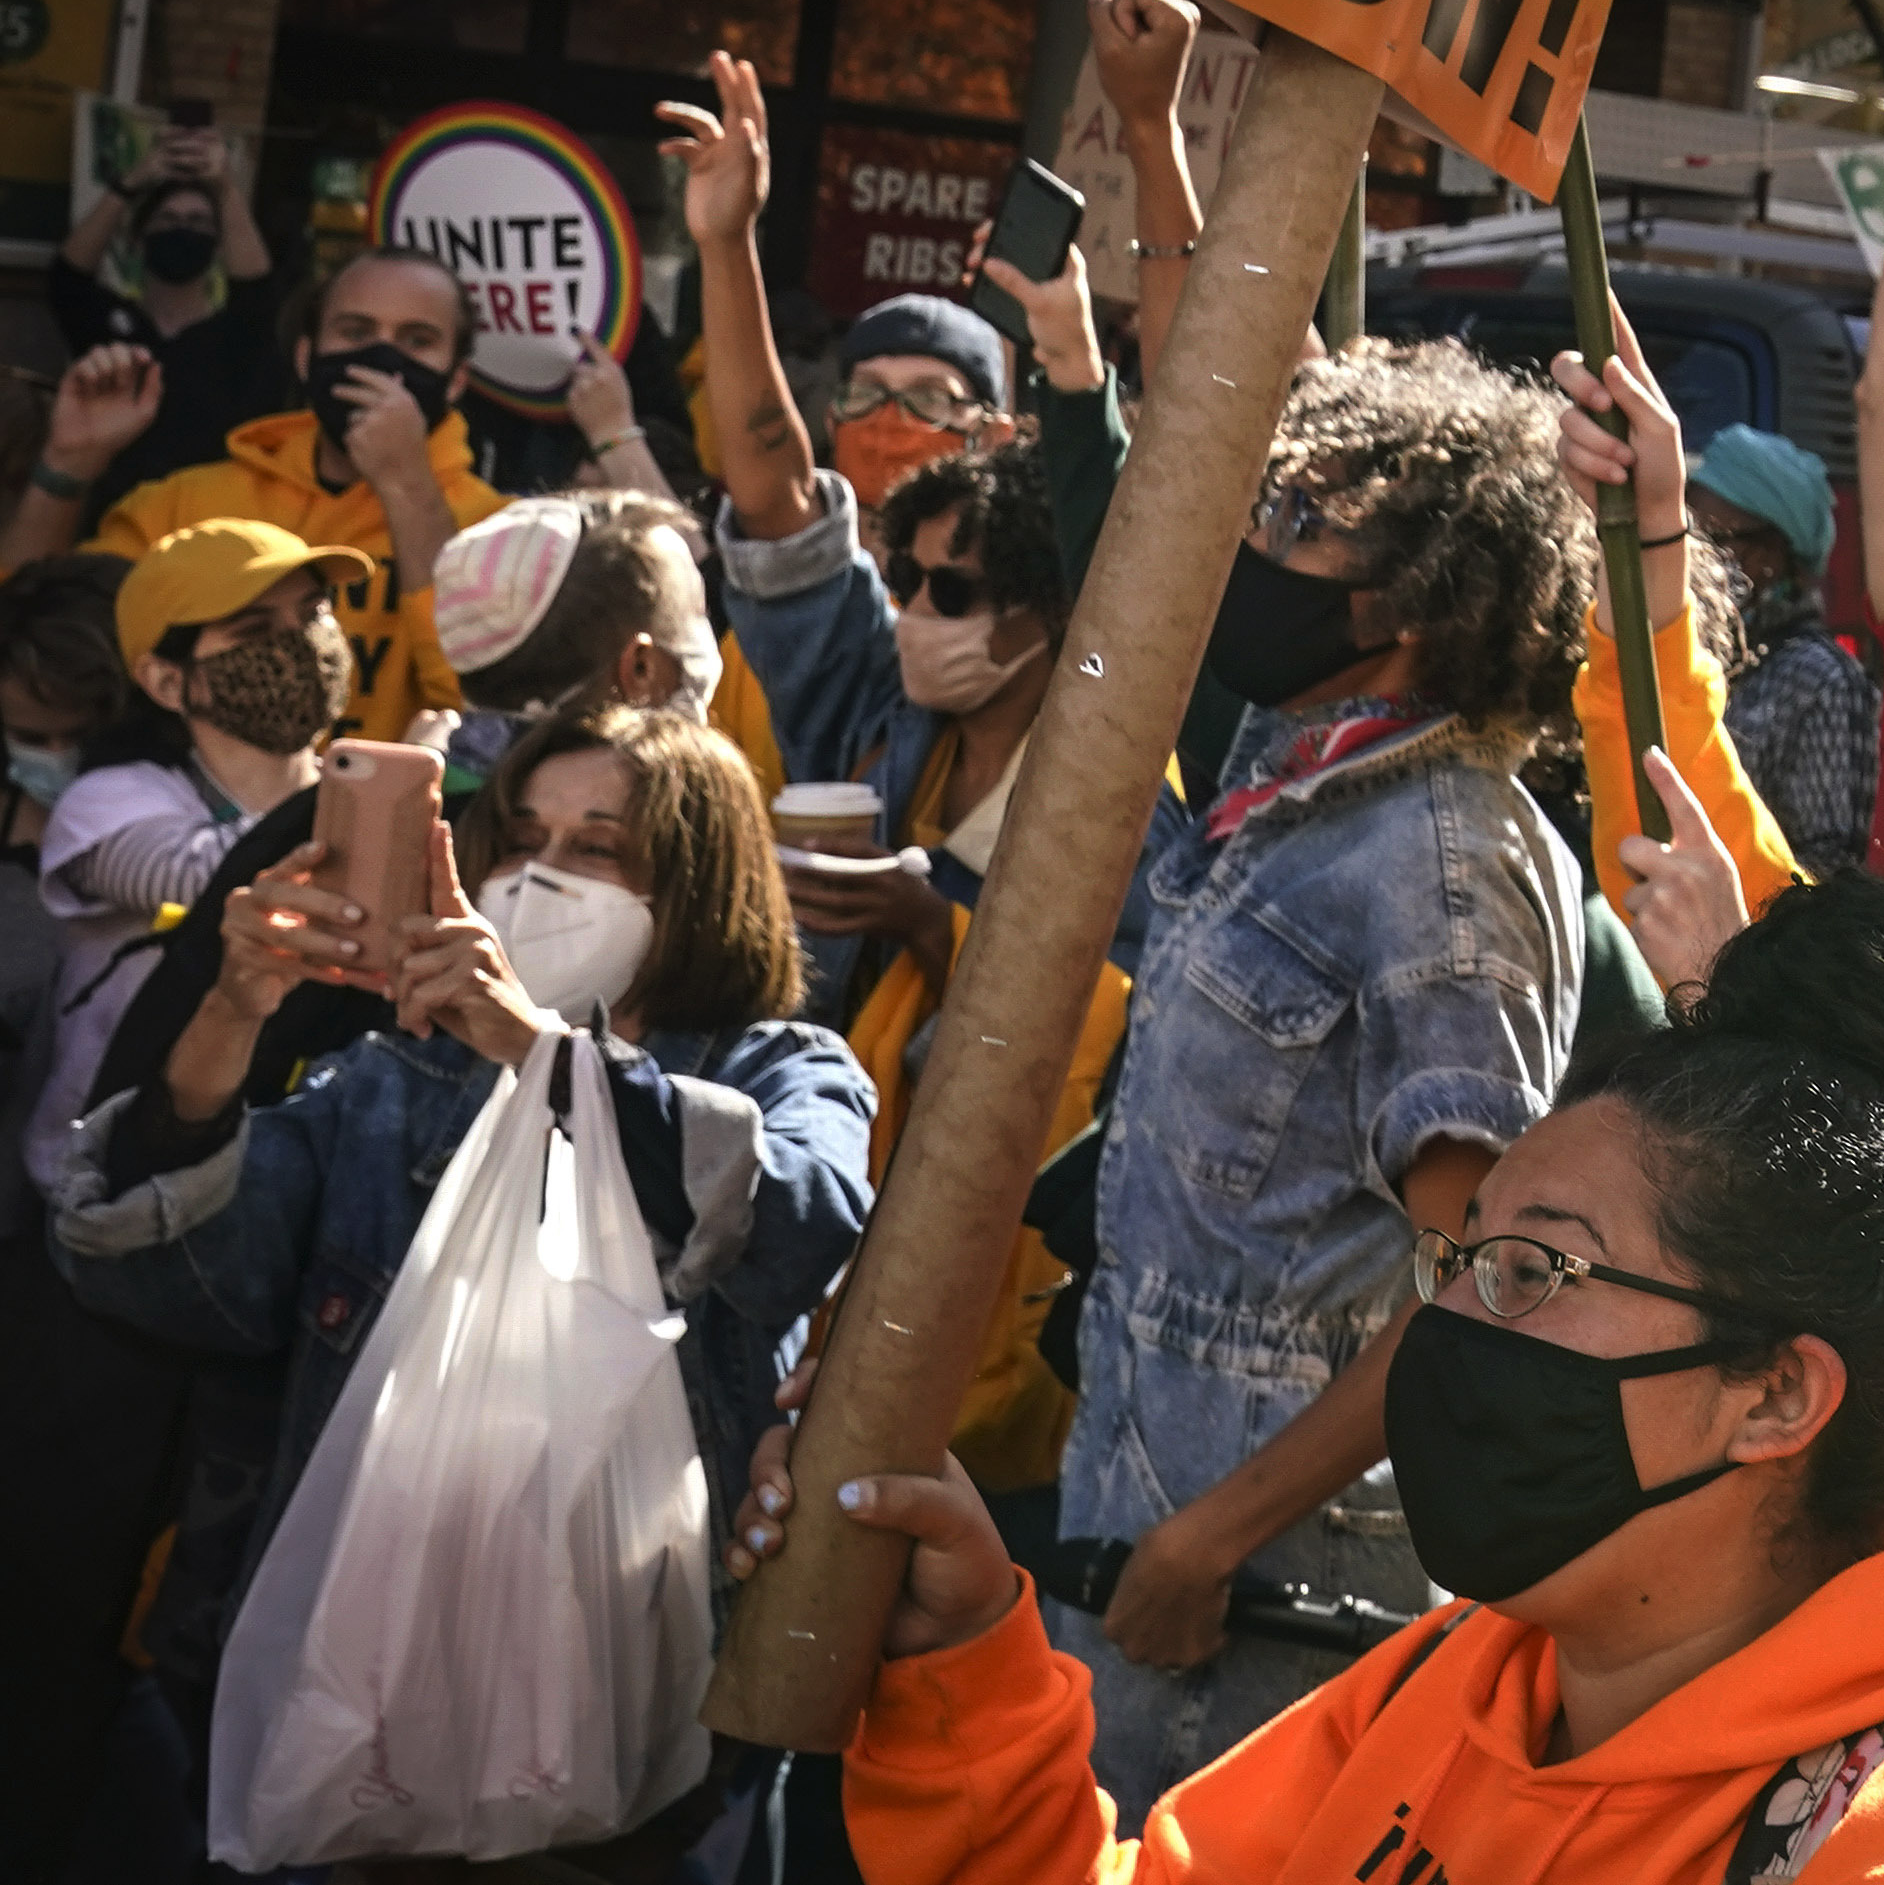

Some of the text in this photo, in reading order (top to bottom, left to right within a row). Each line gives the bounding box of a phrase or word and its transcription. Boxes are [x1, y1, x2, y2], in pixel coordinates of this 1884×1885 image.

[851, 164, 991, 221] SPARE
[863, 233, 964, 288] RIBS
[463, 278, 581, 337] ERE!
